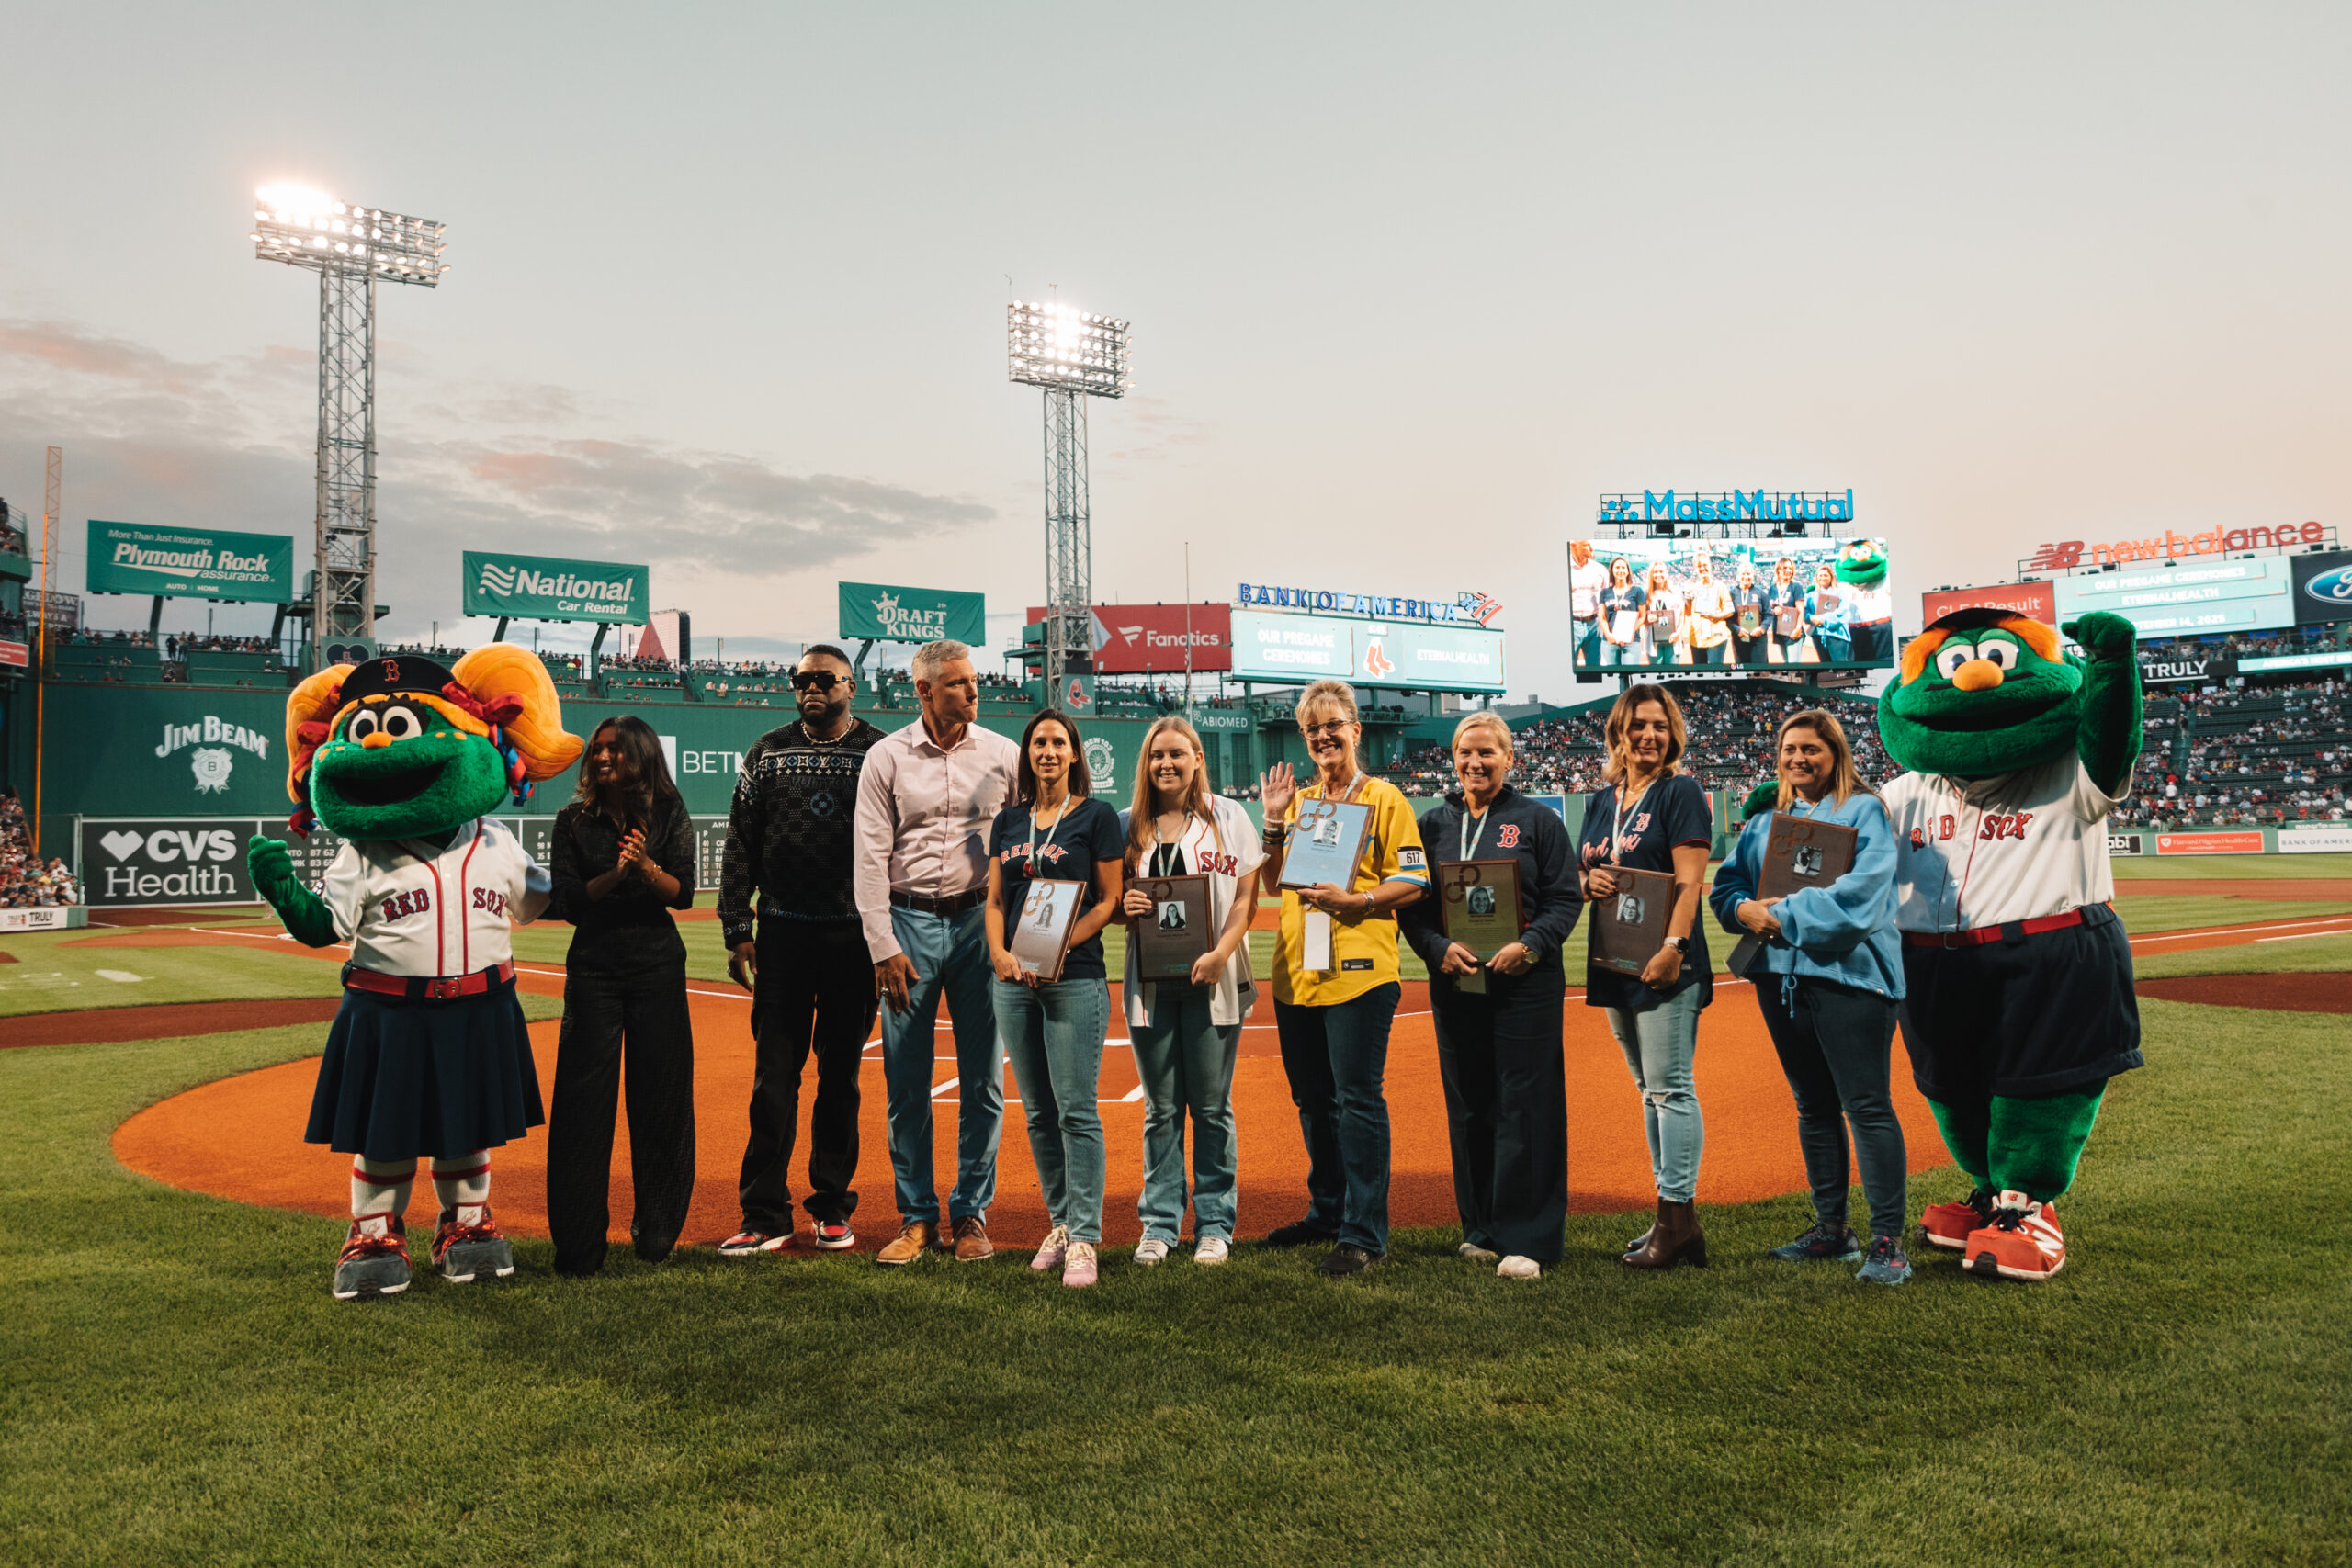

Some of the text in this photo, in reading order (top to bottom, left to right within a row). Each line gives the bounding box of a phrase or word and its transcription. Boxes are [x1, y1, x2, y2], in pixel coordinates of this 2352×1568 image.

[1644, 489, 1854, 521] MassMutual
[107, 529, 214, 546] More Than Just Insurance.
[114, 542, 269, 572] Plymouth Rock
[515, 570, 634, 602] National
[2095, 566, 2246, 591] OUR PREGAME CEREMONIES
[1239, 583, 1458, 622] BANK OF AMERICA
[2121, 587, 2220, 606] ETERNALHEALTH
[557, 600, 628, 615] Car Rental
[876, 606, 947, 625] DRAFT
[1936, 596, 2041, 618] CLResult
[886, 622, 946, 639] KINGS
[1147, 630, 1219, 647] Fanatics
[1258, 628, 1334, 648] OUR PREGAME
[1263, 649, 1330, 665] CEREMONIES
[1417, 649, 1490, 665] ETERNALHEALTH
[382, 660, 400, 682] B
[2143, 661, 2208, 678] TRULY
[1202, 716, 1248, 728] ABIOMED
[155, 716, 267, 760] JIM BEAM
[208, 762, 217, 772] B
[1629, 812, 1651, 832] B
[146, 830, 237, 862] CVS
[1497, 824, 1521, 848] B
[2173, 837, 2199, 846] Harvard
[2199, 837, 2222, 847] Pilgrim
[1200, 851, 1238, 878] SOX
[1406, 852, 1420, 865] 617
[105, 866, 237, 897] Health
[381, 887, 506, 923] RED SOX
[29, 911, 53, 923] TRULY
